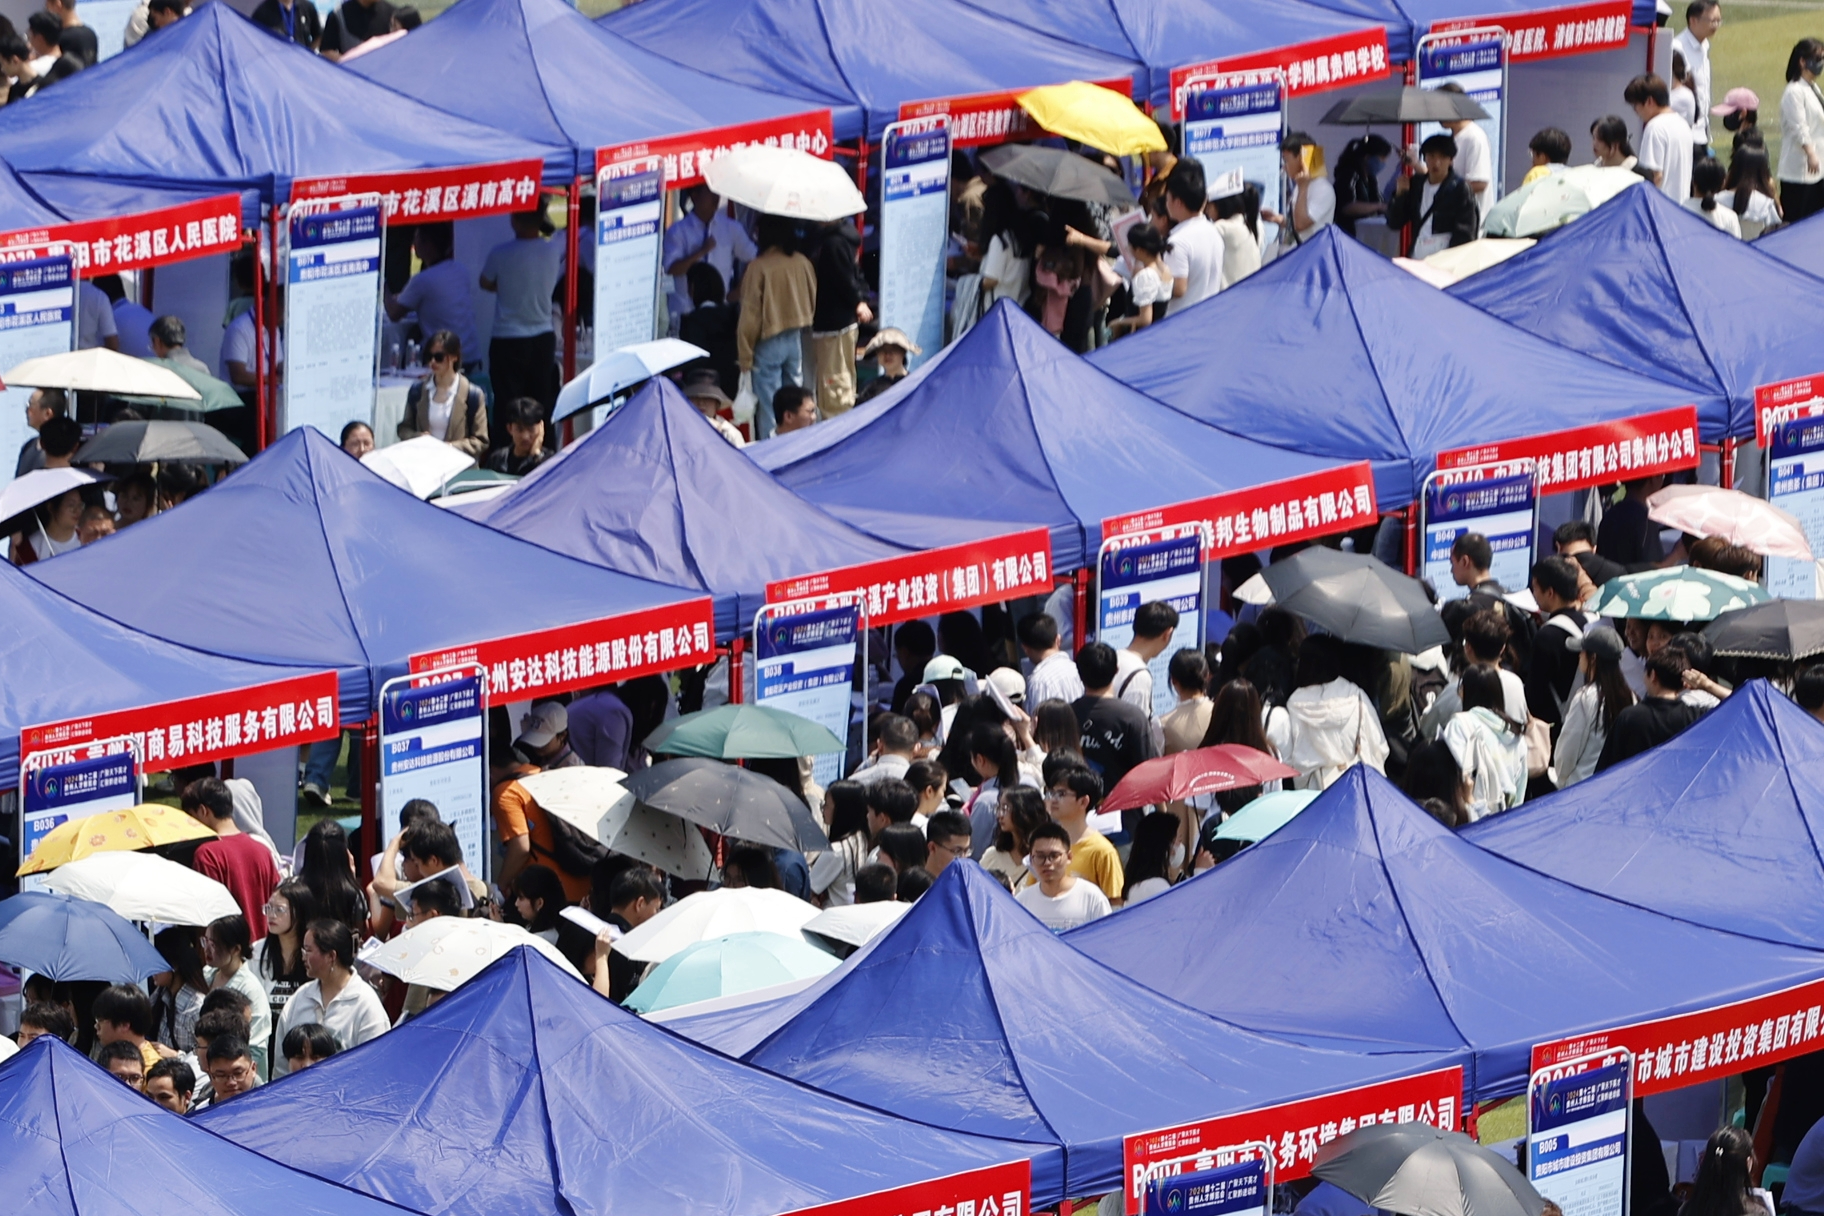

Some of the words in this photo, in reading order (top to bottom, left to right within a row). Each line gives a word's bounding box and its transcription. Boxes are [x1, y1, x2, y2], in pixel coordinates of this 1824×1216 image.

[1109, 595, 1129, 607] B039
[391, 741, 410, 755] B037
[33, 817, 55, 831] B036
[1539, 1138, 1557, 1154] B005
[1535, 1140, 1621, 1178] 贵阳市城市建设投资集团有限公司
